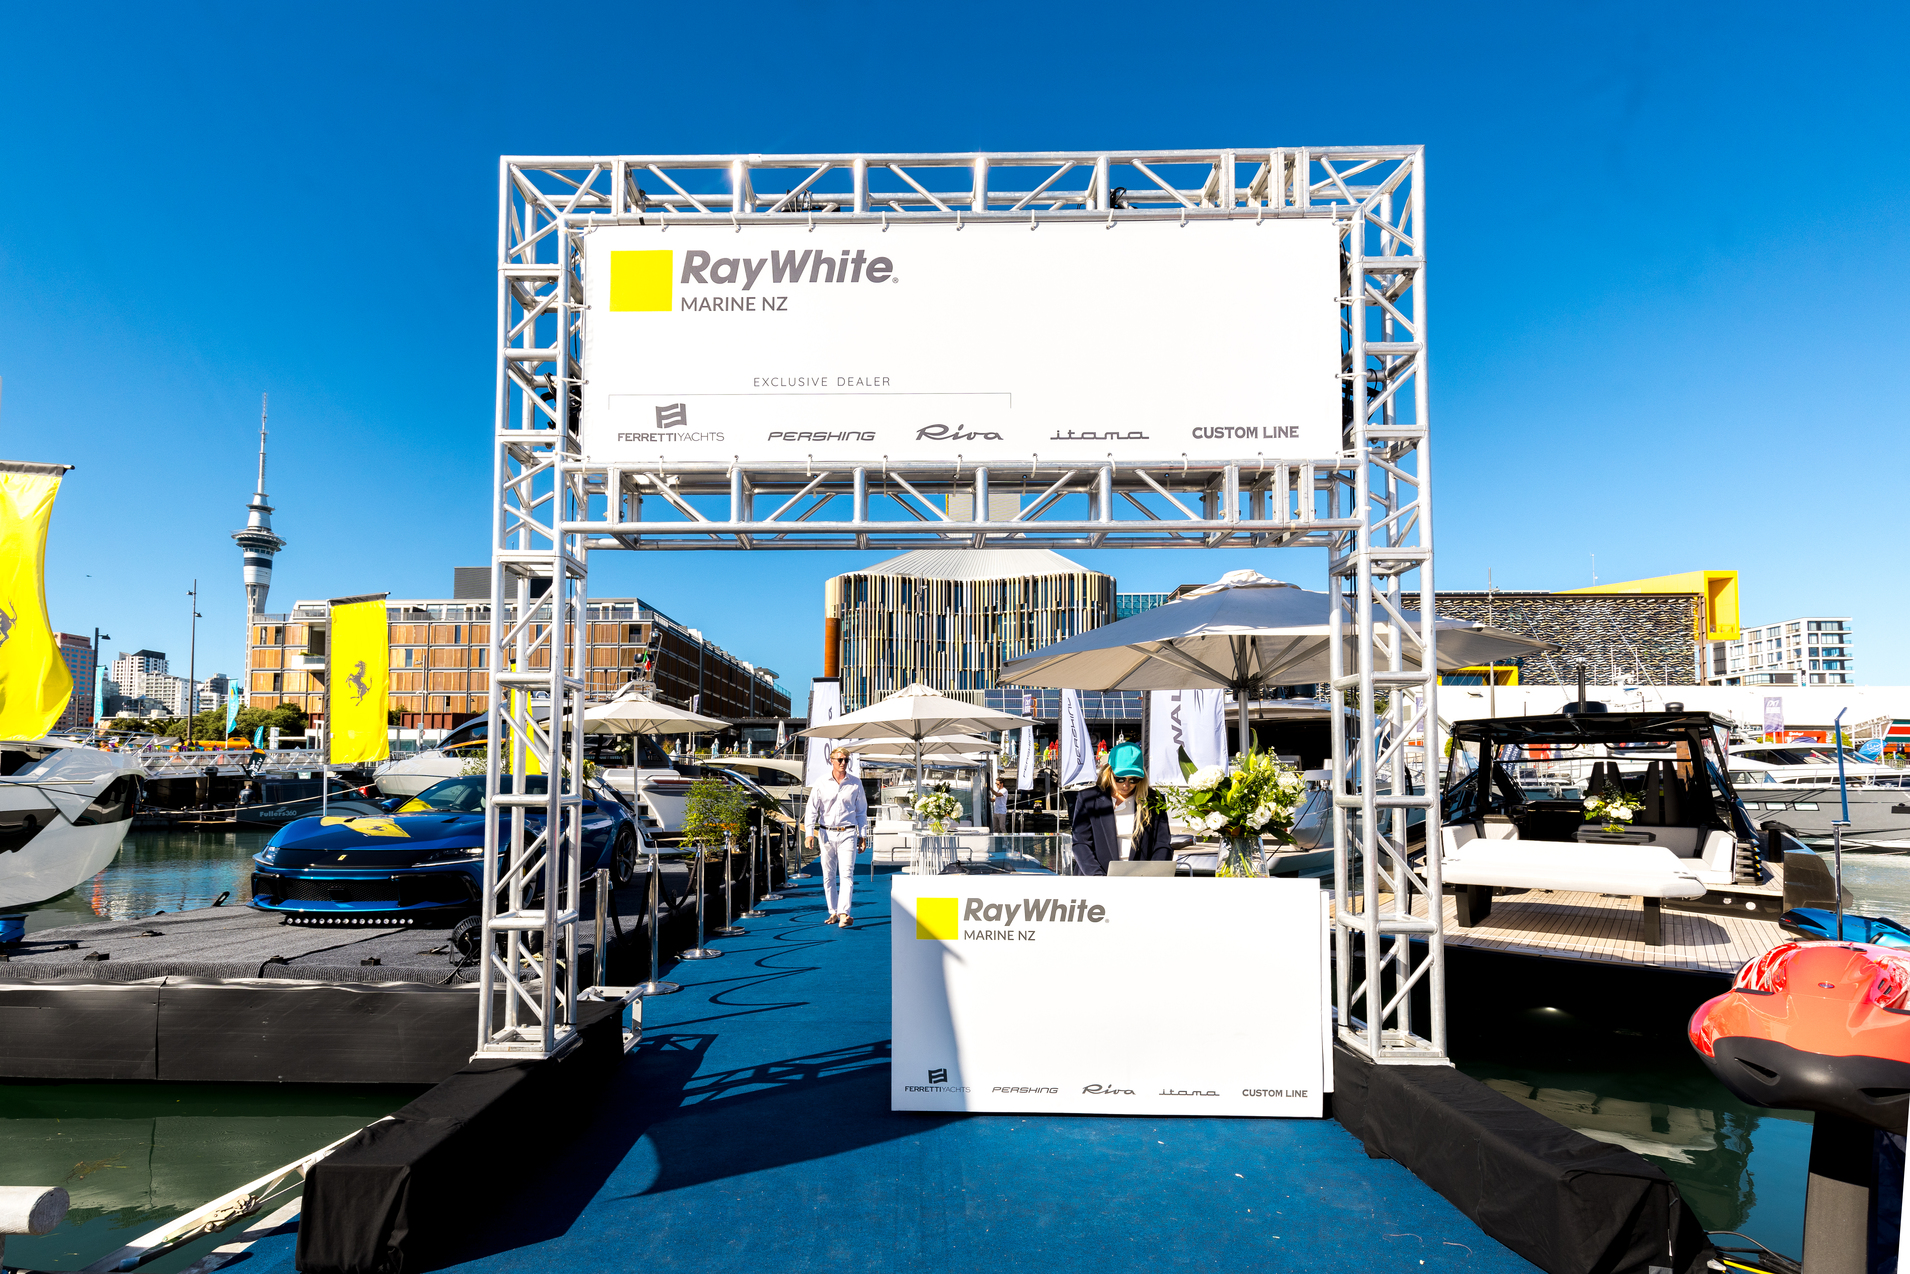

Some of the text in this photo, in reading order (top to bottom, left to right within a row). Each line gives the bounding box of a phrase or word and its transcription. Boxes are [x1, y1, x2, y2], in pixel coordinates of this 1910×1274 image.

[681, 296, 789, 312] MARINE NZ
[753, 376, 891, 388] EXCLUSIVE DEALER
[767, 431, 877, 442] PERSHING
[915, 423, 1004, 441] Riva
[1191, 425, 1300, 440] CUSTOM LINE
[964, 929, 1036, 942] MARINE NZ
[991, 1086, 1059, 1095] PERSHING
[1081, 1083, 1137, 1096] Riva
[1241, 1088, 1309, 1098] CUSTOM LINE
